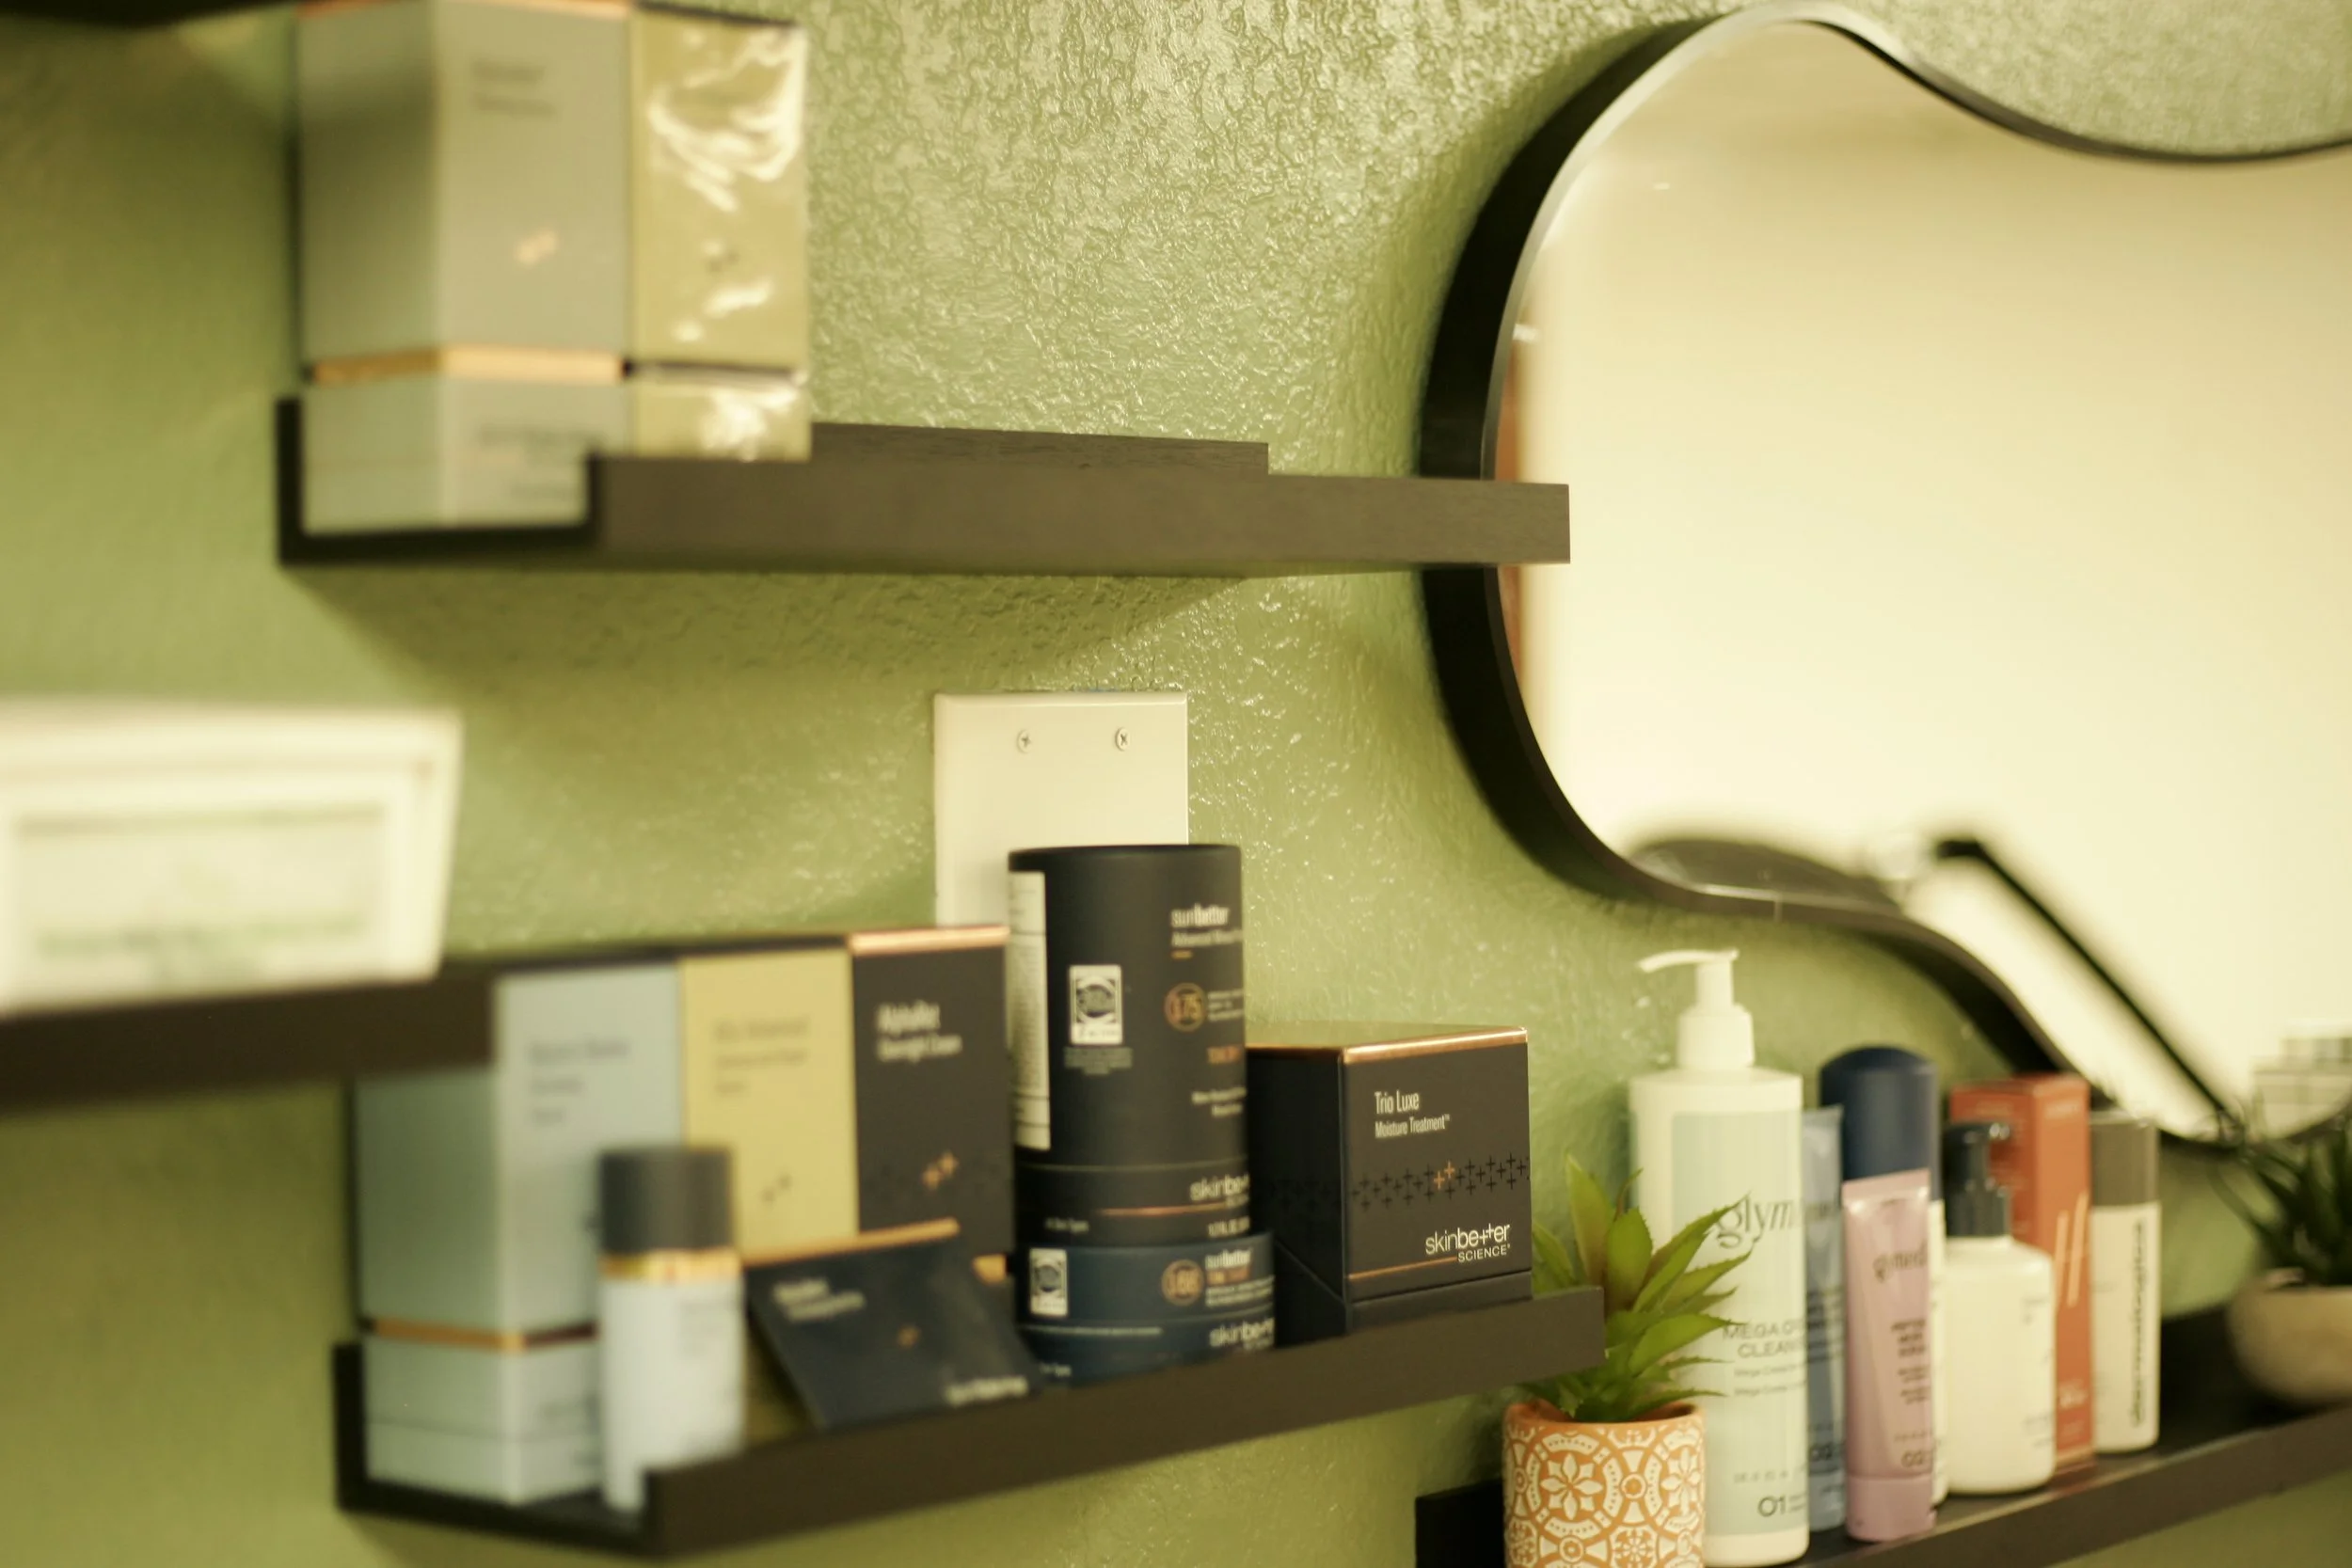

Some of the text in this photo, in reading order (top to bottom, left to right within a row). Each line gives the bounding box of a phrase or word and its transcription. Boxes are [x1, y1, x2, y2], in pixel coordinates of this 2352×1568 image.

[1375, 1088, 1421, 1115] Trio Luxe
[1375, 1120, 1409, 1139] Moisture
